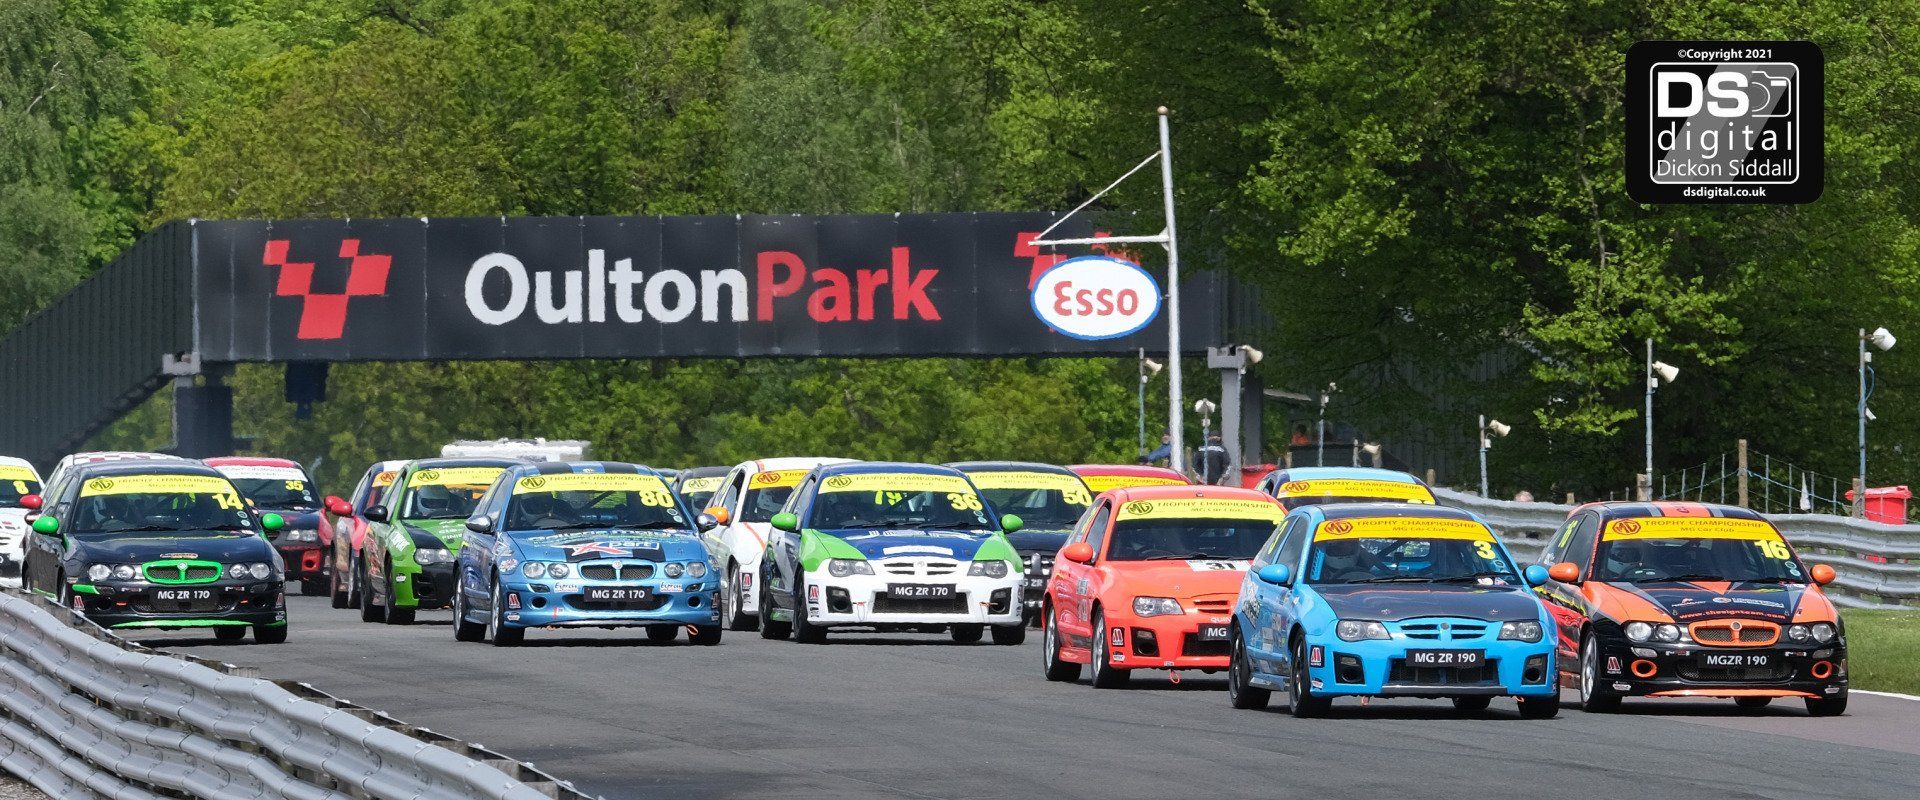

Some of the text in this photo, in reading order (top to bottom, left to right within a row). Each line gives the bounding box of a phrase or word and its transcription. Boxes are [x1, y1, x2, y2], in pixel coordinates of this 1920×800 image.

[1053, 280, 1139, 316] Esso
[13, 480, 29, 495] 8
[285, 480, 304, 491] 35
[1353, 481, 1421, 490] CHAMPIONSHIP
[212, 493, 245, 510] 14
[638, 491, 675, 508] 80
[947, 493, 983, 511] 36
[1061, 489, 1094, 508] 50
[1199, 501, 1273, 509] CHAMPIONSHIP
[1401, 519, 1478, 529] CHAMPIONSHIP
[1612, 519, 1641, 535] MG
[1689, 520, 1764, 529] CHAMPIONSHIP
[1473, 540, 1496, 560] 3
[1754, 540, 1791, 560] 16
[157, 589, 210, 599] MG ZR 170
[592, 590, 645, 599] MG ZR 170
[895, 587, 949, 596] MG ZR 170
[1207, 627, 1227, 637] MG
[1415, 652, 1476, 663] MG ZR 190
[1706, 655, 1767, 666] MGZR 190
